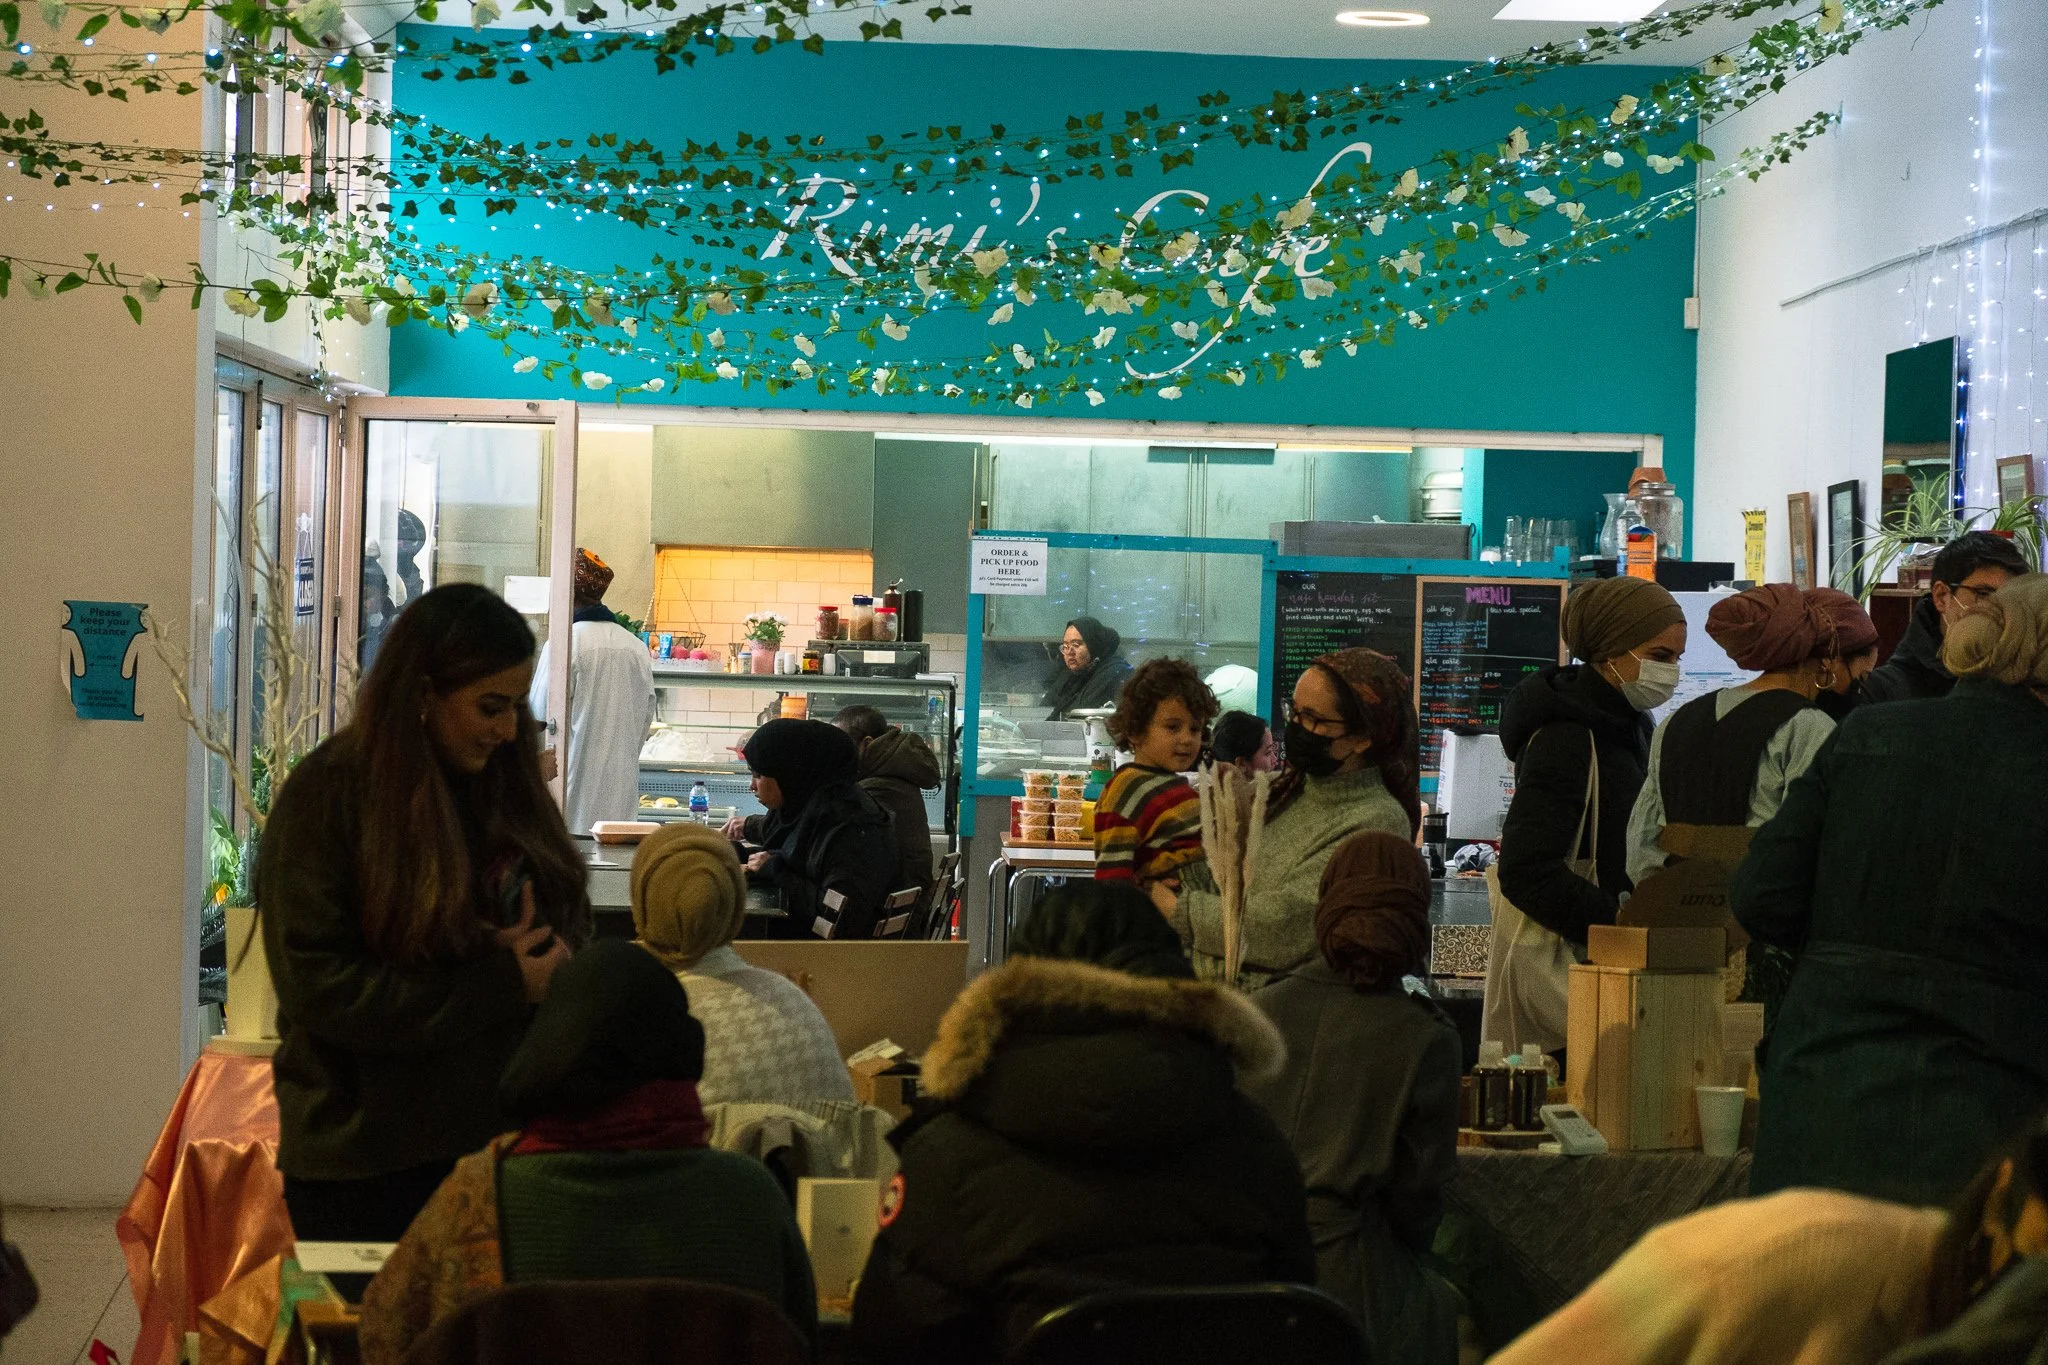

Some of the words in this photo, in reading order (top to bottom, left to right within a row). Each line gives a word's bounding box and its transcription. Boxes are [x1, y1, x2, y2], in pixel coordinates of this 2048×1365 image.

[991, 549, 1020, 557] ORDER
[980, 558, 1001, 566] PICK
[1015, 559, 1039, 567] FOOD
[998, 568, 1021, 576] HERE
[1465, 586, 1511, 606] MENU
[89, 607, 122, 617] Please
[1427, 605, 1437, 613] all
[1519, 606, 1541, 616] special
[80, 616, 104, 625] keep
[108, 619, 129, 628] your
[83, 626, 127, 636] distance
